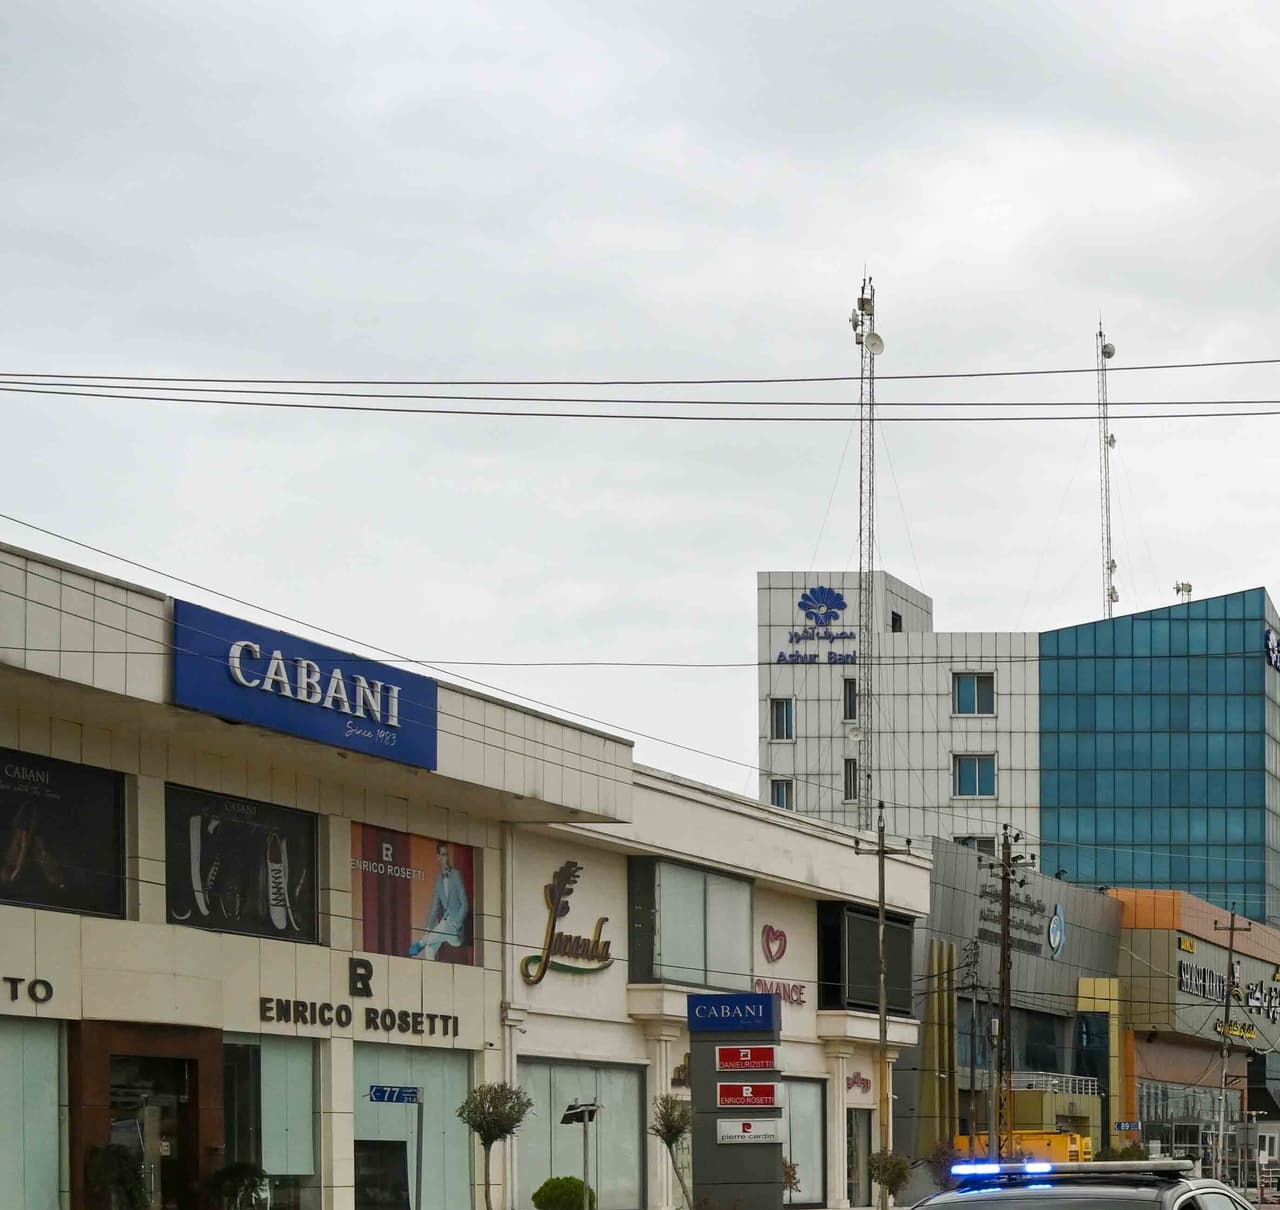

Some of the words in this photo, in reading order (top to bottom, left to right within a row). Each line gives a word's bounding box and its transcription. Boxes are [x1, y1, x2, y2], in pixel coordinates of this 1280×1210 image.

[777, 651, 820, 664] Ashur
[228, 640, 402, 728] CABANI
[344, 720, 374, 738] Since
[375, 729, 398, 746] 1983
[4, 763, 49, 784] CABANI
[351, 859, 385, 874] ENRICO
[387, 865, 425, 881] ROSETTI
[2, 976, 54, 1004] TO
[260, 997, 352, 1029] ENRICO
[365, 1007, 459, 1037] ROSETTI
[695, 1005, 764, 1018] CABANI
[383, 1087, 401, 1102] 77
[746, 1096, 775, 1104] ROSETTI
